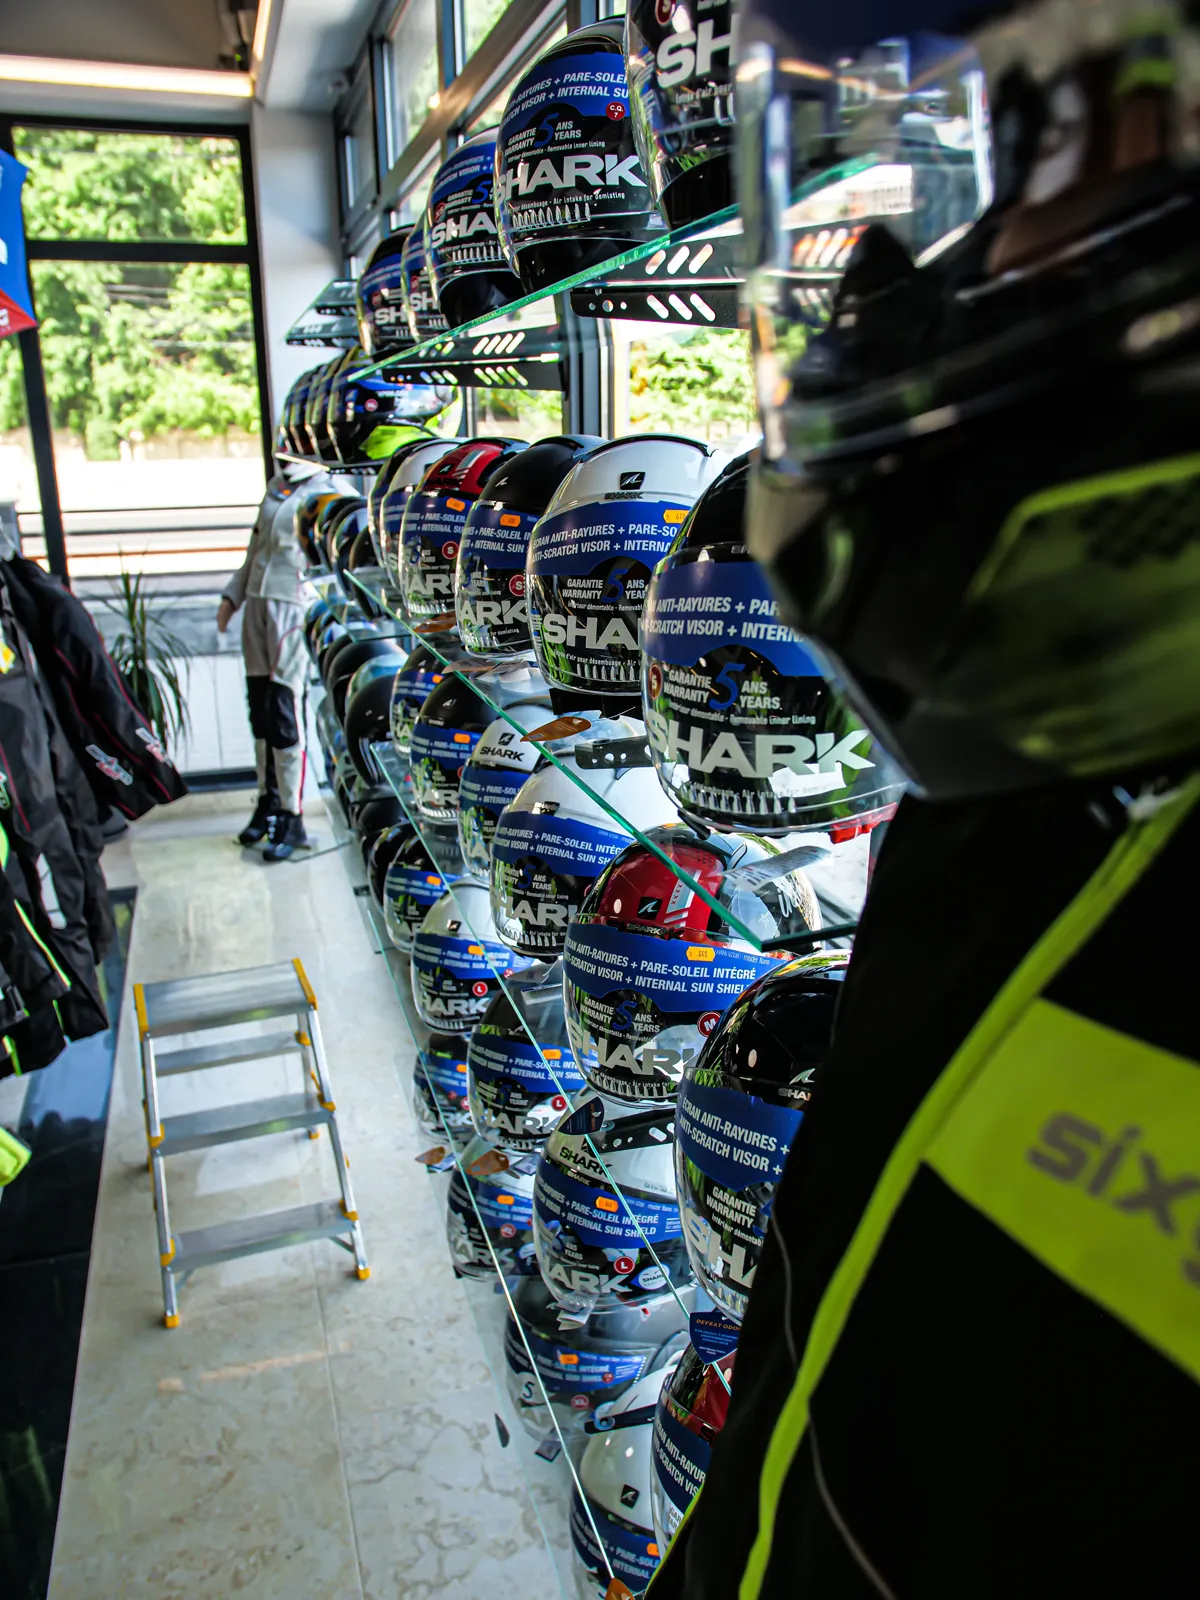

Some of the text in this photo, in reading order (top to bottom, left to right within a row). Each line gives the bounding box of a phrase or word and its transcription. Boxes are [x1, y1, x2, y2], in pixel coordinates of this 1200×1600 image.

[557, 86, 610, 98] INTERNAL
[554, 130, 582, 140] YEARS
[556, 121, 574, 131] ANS
[479, 527, 521, 540] PARE-SOLEIL
[549, 524, 615, 544] ANTI-RAYURES
[475, 540, 524, 553] INTERNAL SUN
[532, 544, 578, 562] ANTI-SCRATCH
[581, 541, 610, 553] VISOR
[567, 578, 604, 589] GARANTIE
[601, 569, 628, 603] 5
[626, 579, 645, 589] ANS
[562, 588, 602, 600] WARRANTY
[656, 597, 732, 613] ANTI-RAYURES
[543, 613, 641, 651] SHA
[686, 619, 724, 636] VISOR
[668, 669, 712, 690] GARANTIE
[709, 662, 746, 711] 5
[741, 680, 768, 694] ANS
[663, 681, 710, 704] WARRANTY
[739, 695, 781, 710] YEARS
[791, 714, 816, 726] lining
[647, 709, 876, 779] SHARK
[480, 746, 525, 762] SHARK
[541, 832, 593, 851] PARE-SOLEIL
[536, 844, 575, 861] INTERNAL
[577, 852, 596, 864] SUN
[532, 882, 552, 890] YEARS
[626, 923, 662, 936] SHARK
[576, 943, 756, 980] ANTI-RAYURES PARE-SOLEIL INTÉGRÉ
[597, 965, 623, 982] VISOR
[635, 975, 688, 993] INTERNAL
[691, 982, 714, 993] SUN
[580, 1006, 612, 1024] WARRANTY
[584, 997, 614, 1015] GARANTIE
[612, 1001, 637, 1030] 5
[634, 1013, 652, 1023] ANS
[704, 1018, 716, 1030] M
[632, 1023, 661, 1033] YEARS
[682, 1095, 701, 1121] ÉCRAN
[700, 1112, 778, 1152] ANTI-RAYURES
[680, 1115, 730, 1158] ANTI-SCRATCH
[732, 1147, 770, 1172] VISOR
[560, 1146, 613, 1178] SHARK
[712, 1186, 757, 1217] GARANTIE
[571, 1202, 620, 1224] PARE-SOLEIL
[706, 1195, 754, 1228] WARRANTY
[567, 1213, 603, 1235] INTERNAL
[604, 1225, 623, 1236] SUN
[696, 1318, 722, 1328] DEFEAT
